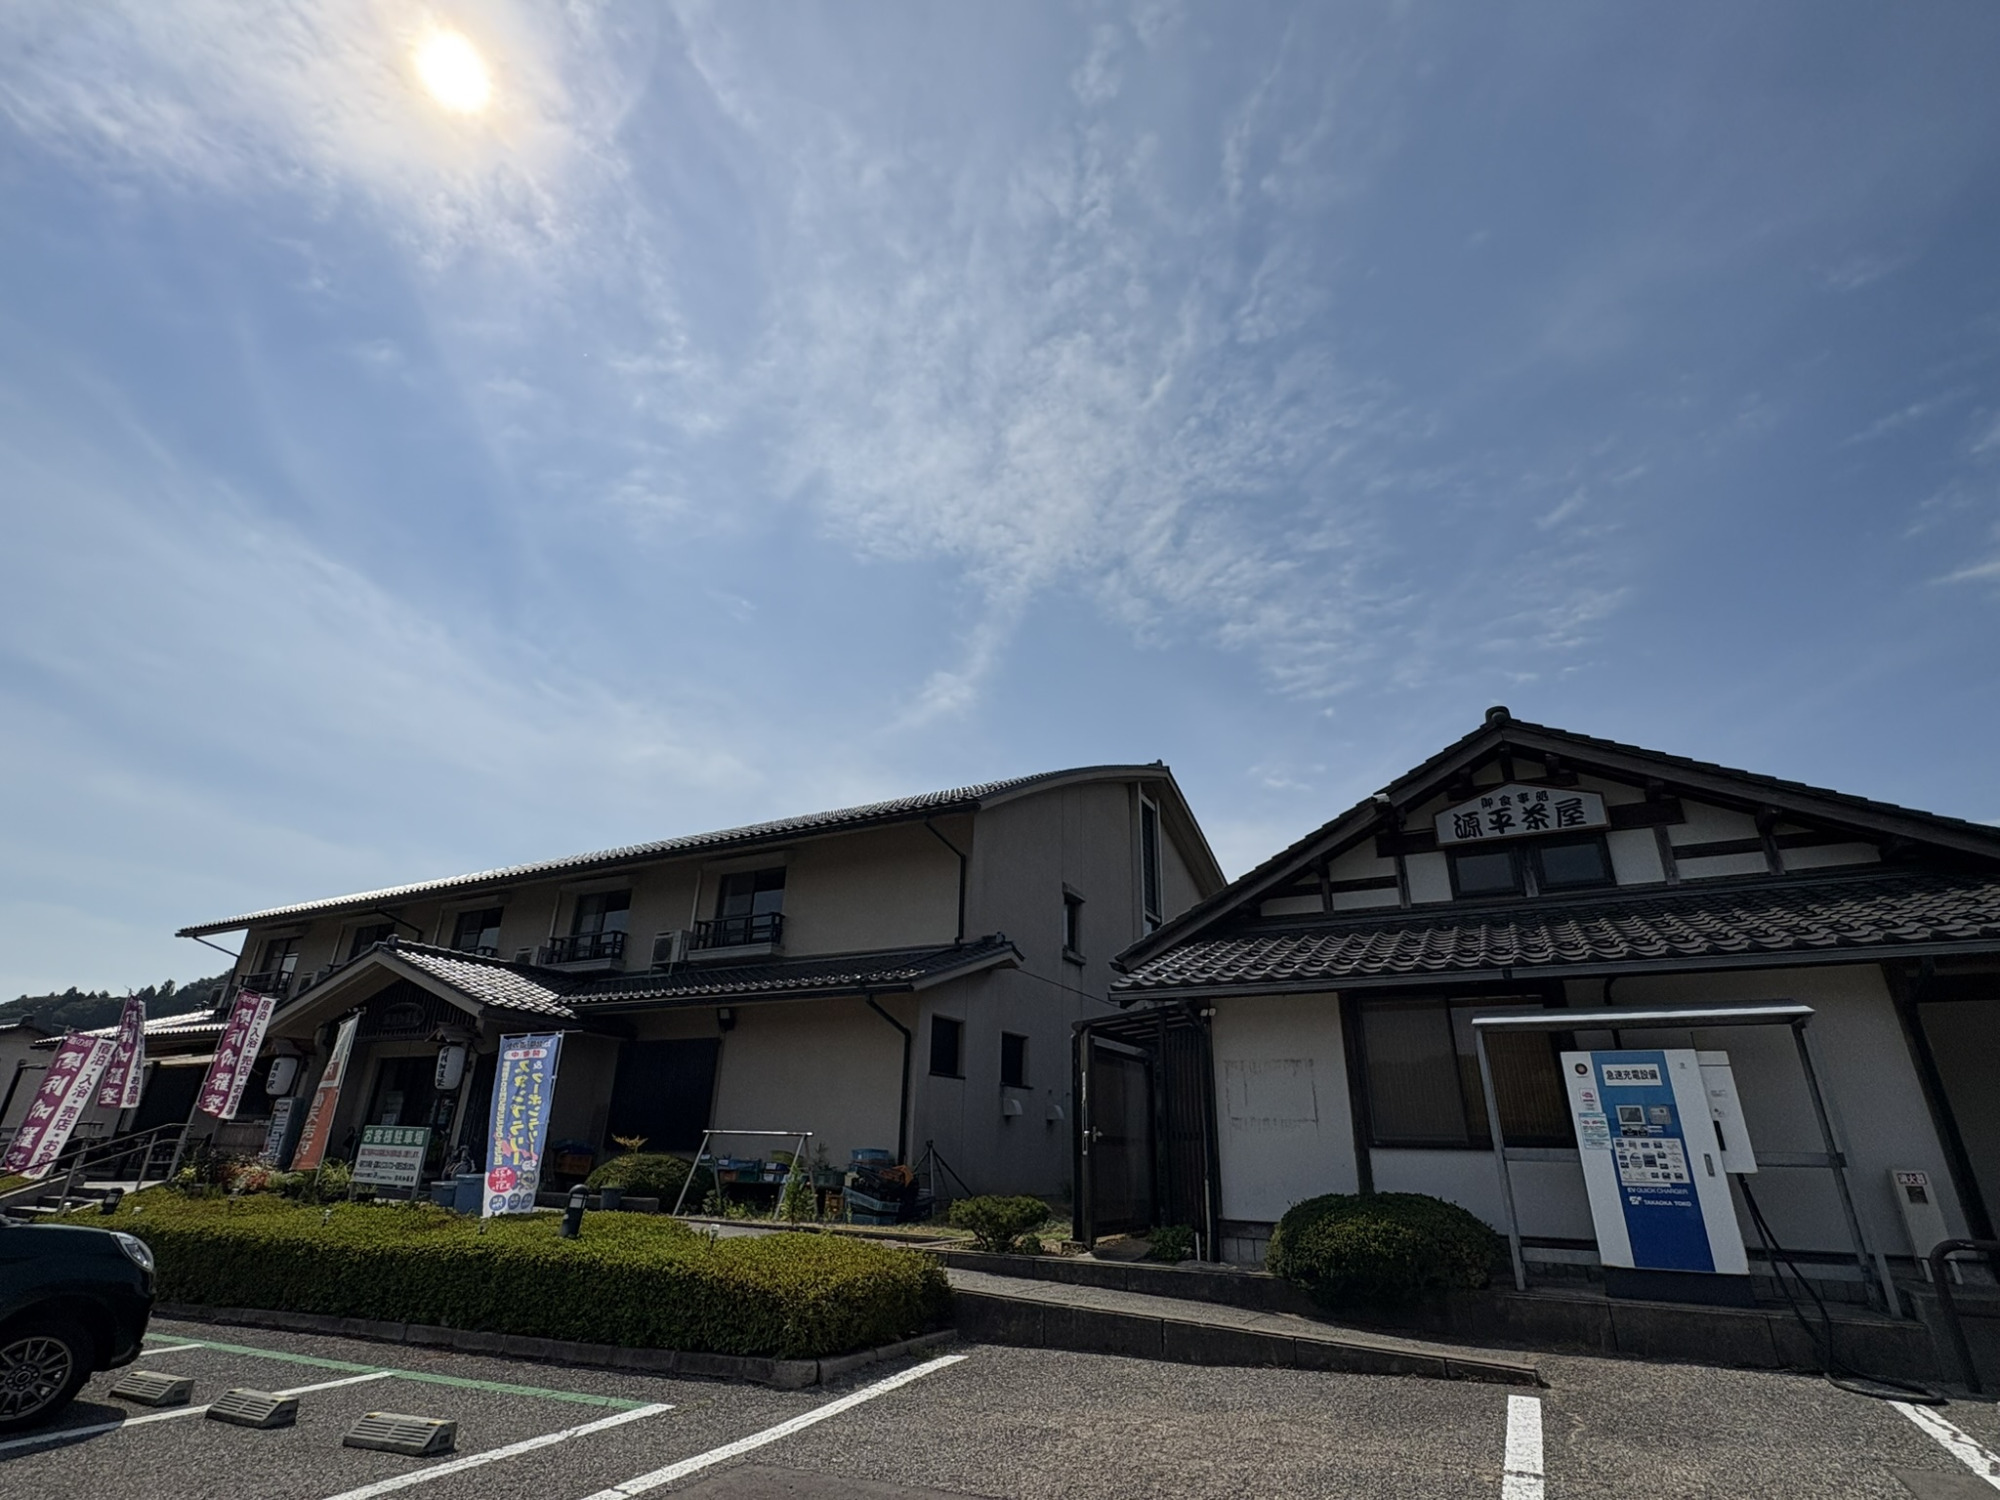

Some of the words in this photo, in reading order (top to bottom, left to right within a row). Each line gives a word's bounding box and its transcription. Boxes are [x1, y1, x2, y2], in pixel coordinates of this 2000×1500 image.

[1481, 790, 1550, 809] 御食事処
[1453, 797, 1587, 839] 源平茶屋
[67, 1035, 95, 1048] 道の駅
[1606, 1069, 1658, 1080] 急速充電設備
[363, 1129, 425, 1145] お客様駐車場
